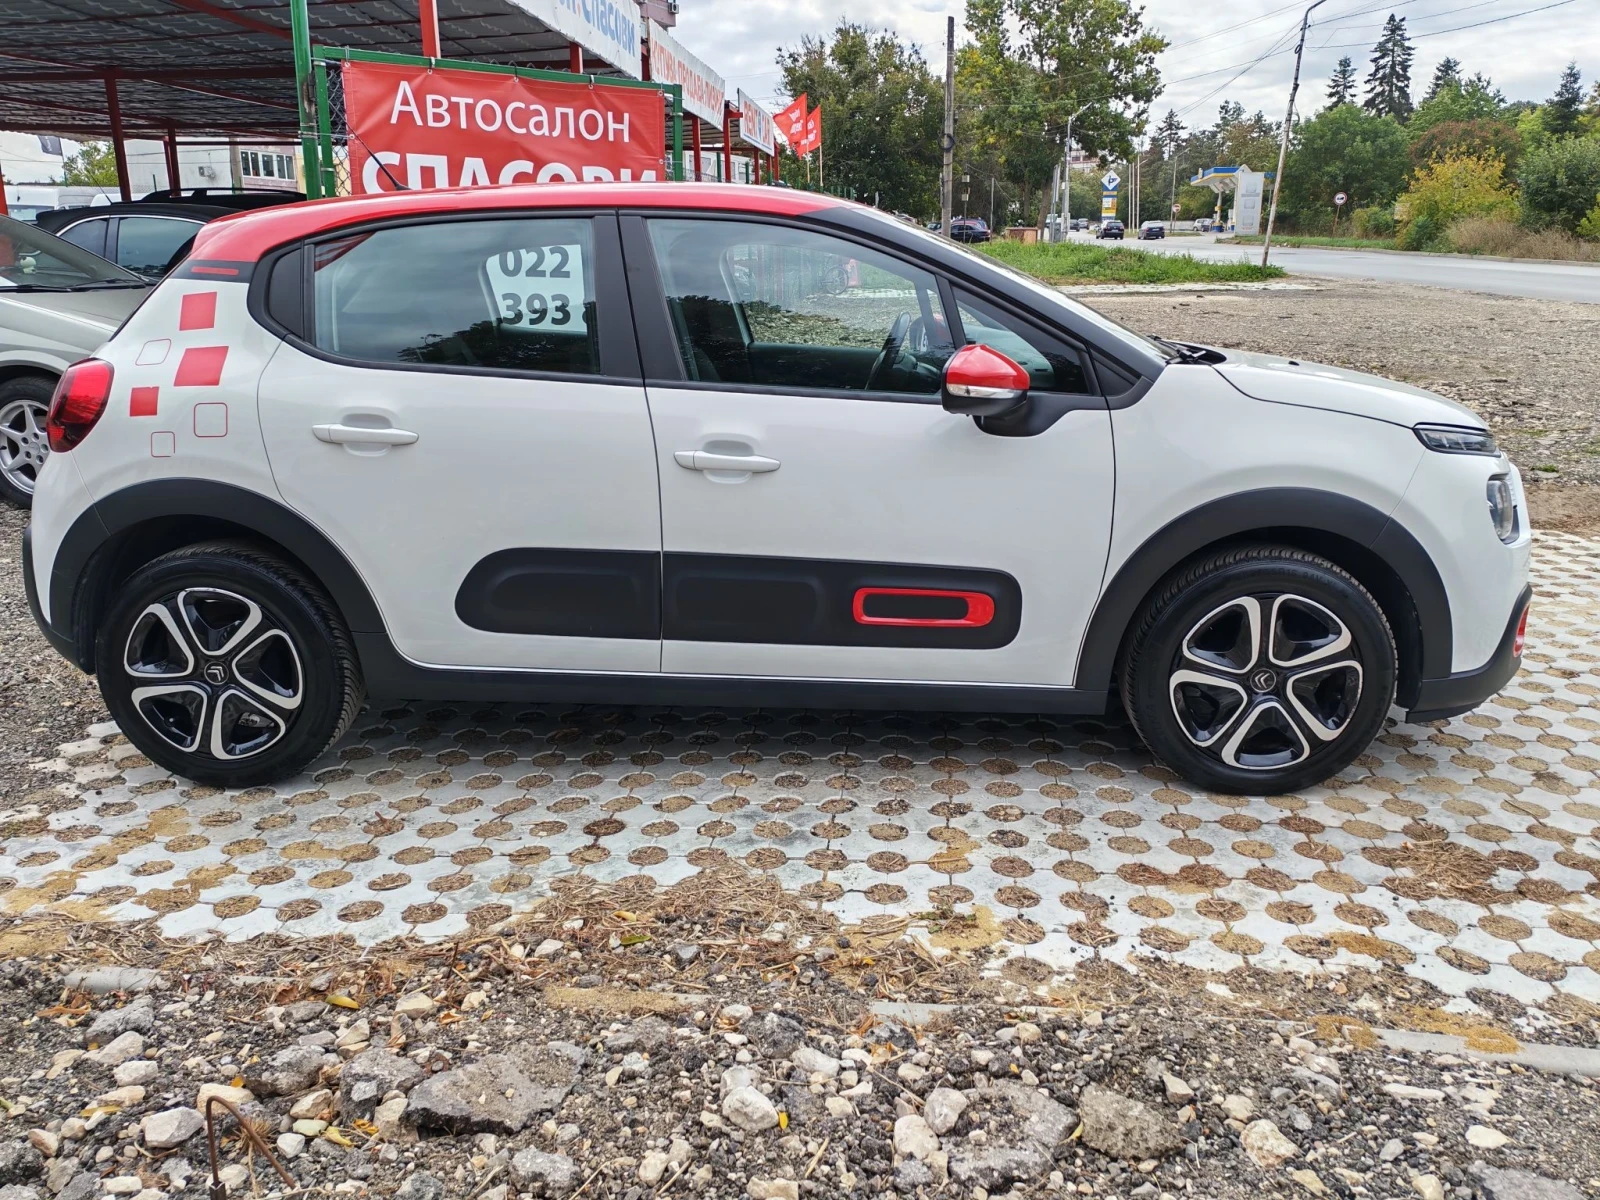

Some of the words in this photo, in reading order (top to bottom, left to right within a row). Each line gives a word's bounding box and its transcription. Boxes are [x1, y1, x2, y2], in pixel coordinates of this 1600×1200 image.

[390, 80, 631, 143] Автосалон
[362, 151, 657, 194] СПАС
[498, 245, 571, 278] 022
[501, 292, 571, 326] 393
